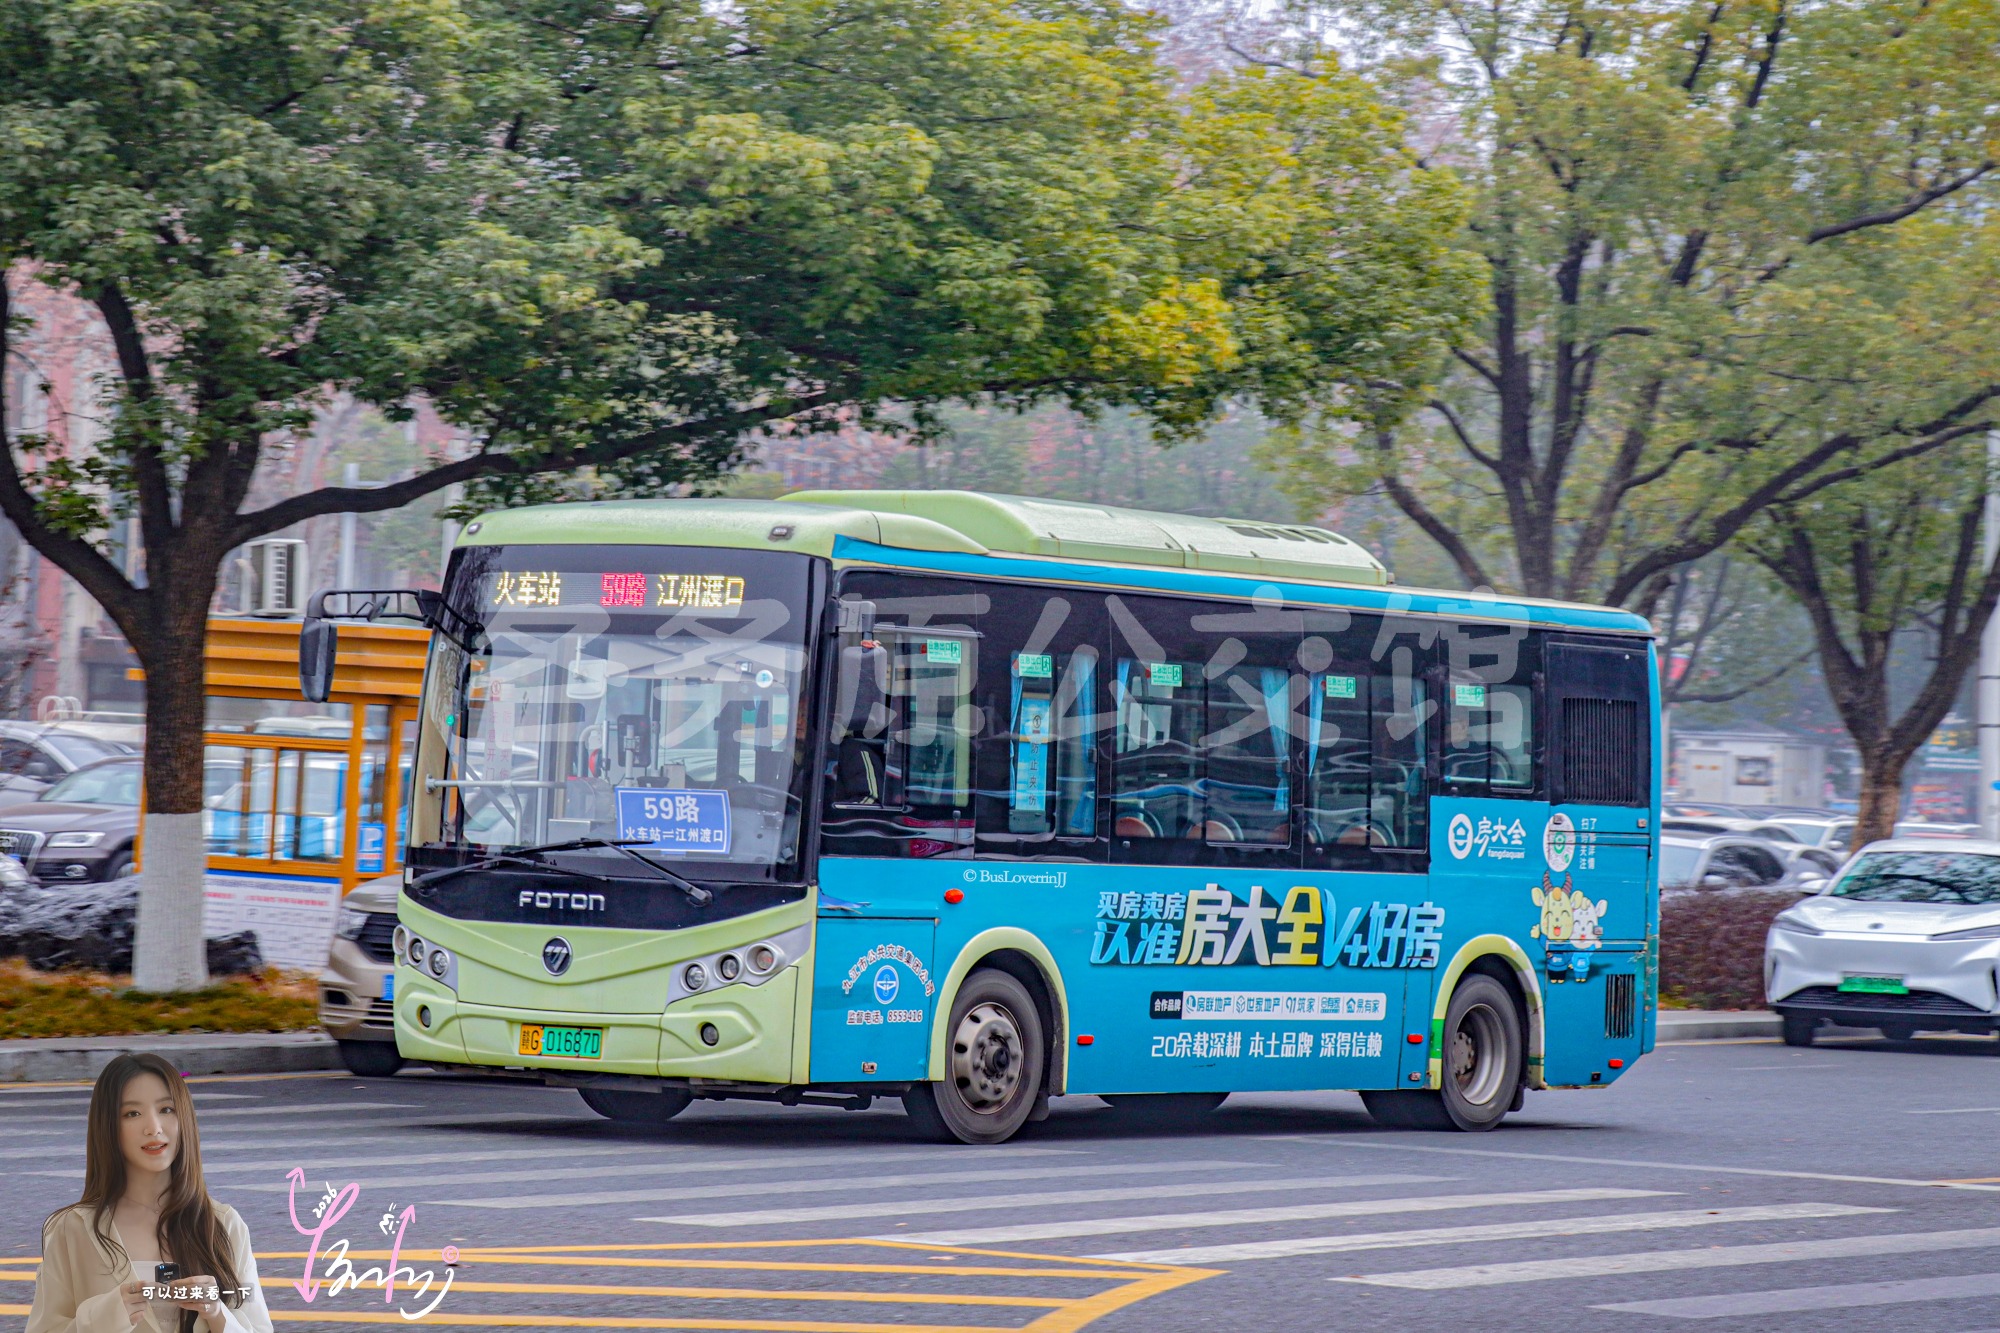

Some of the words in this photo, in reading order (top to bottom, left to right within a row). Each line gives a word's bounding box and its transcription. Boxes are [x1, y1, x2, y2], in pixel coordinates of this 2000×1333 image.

[494, 571, 561, 606] 火车站
[600, 572, 647, 606] 59路
[657, 574, 745, 607] 江州渡口
[644, 795, 700, 823] 59路
[1474, 816, 1527, 857] 房大全
[519, 890, 605, 911] FOTON
[1096, 890, 1187, 920] 买房卖房
[1175, 883, 1323, 966] 房大全
[1089, 921, 1185, 965] 认准
[841, 943, 937, 998] 九江市公共交通集团公司
[887, 1009, 923, 1023] 8553416
[1154, 998, 1182, 1012] 合作品牌
[1151, 1031, 1242, 1058] 20余载深耕
[1249, 1031, 1314, 1058] 本土品牌
[1319, 1031, 1383, 1058] 深得信赖
